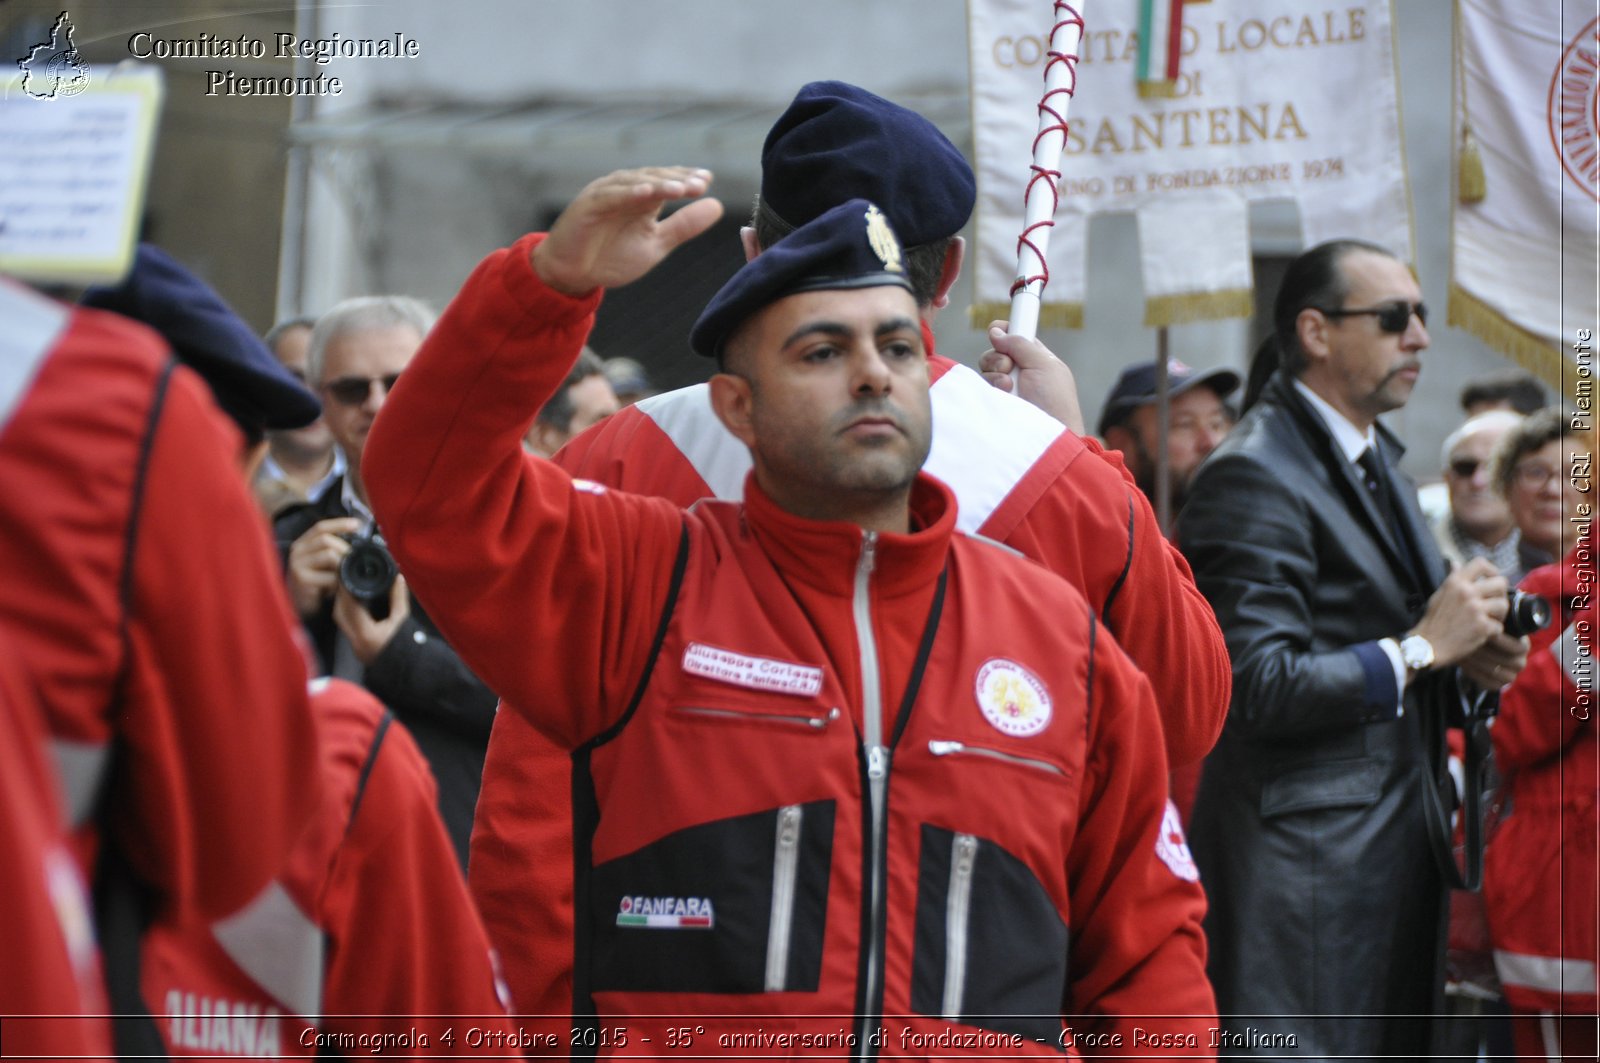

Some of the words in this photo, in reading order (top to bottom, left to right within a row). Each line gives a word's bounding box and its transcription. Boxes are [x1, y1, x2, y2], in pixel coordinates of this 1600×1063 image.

[992, 24, 1200, 70] COITAO
[1215, 7, 1366, 55] LOCALE
[1064, 101, 1308, 155] SANTENA
[1113, 174, 1139, 194] DI
[1146, 161, 1292, 193] FONDAZIONE
[633, 896, 712, 916] FANFARA
